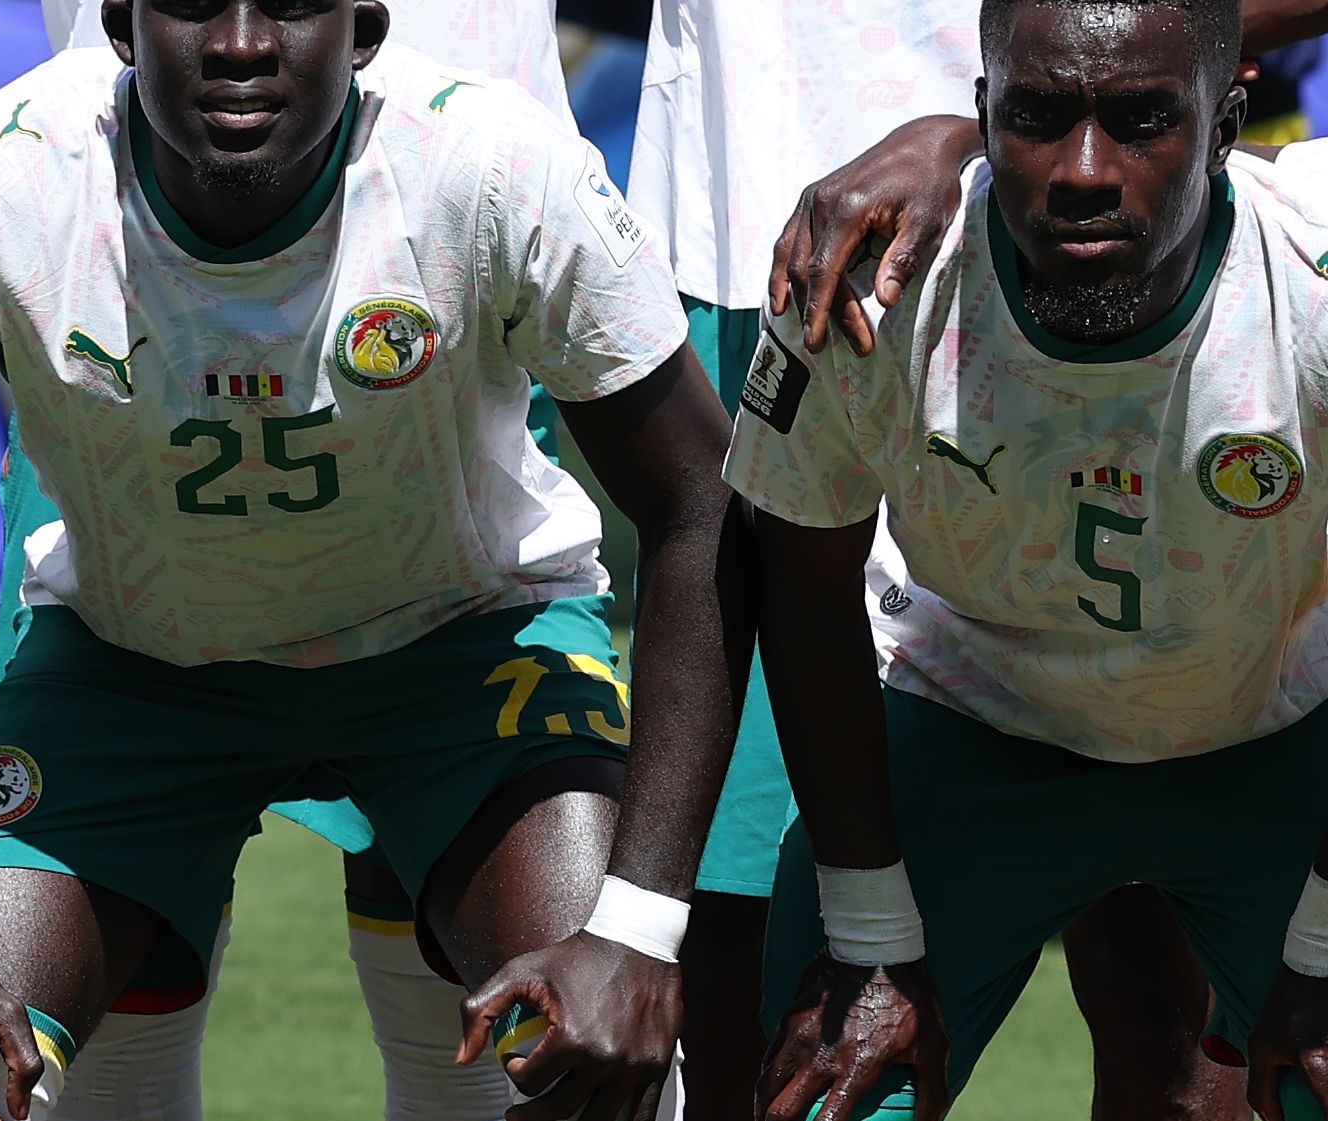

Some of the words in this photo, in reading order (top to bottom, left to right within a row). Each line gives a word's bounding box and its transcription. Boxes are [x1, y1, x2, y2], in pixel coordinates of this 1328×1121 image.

[742, 389, 772, 417] 026
[170, 404, 341, 517] 25
[1074, 502, 1149, 632] 5
